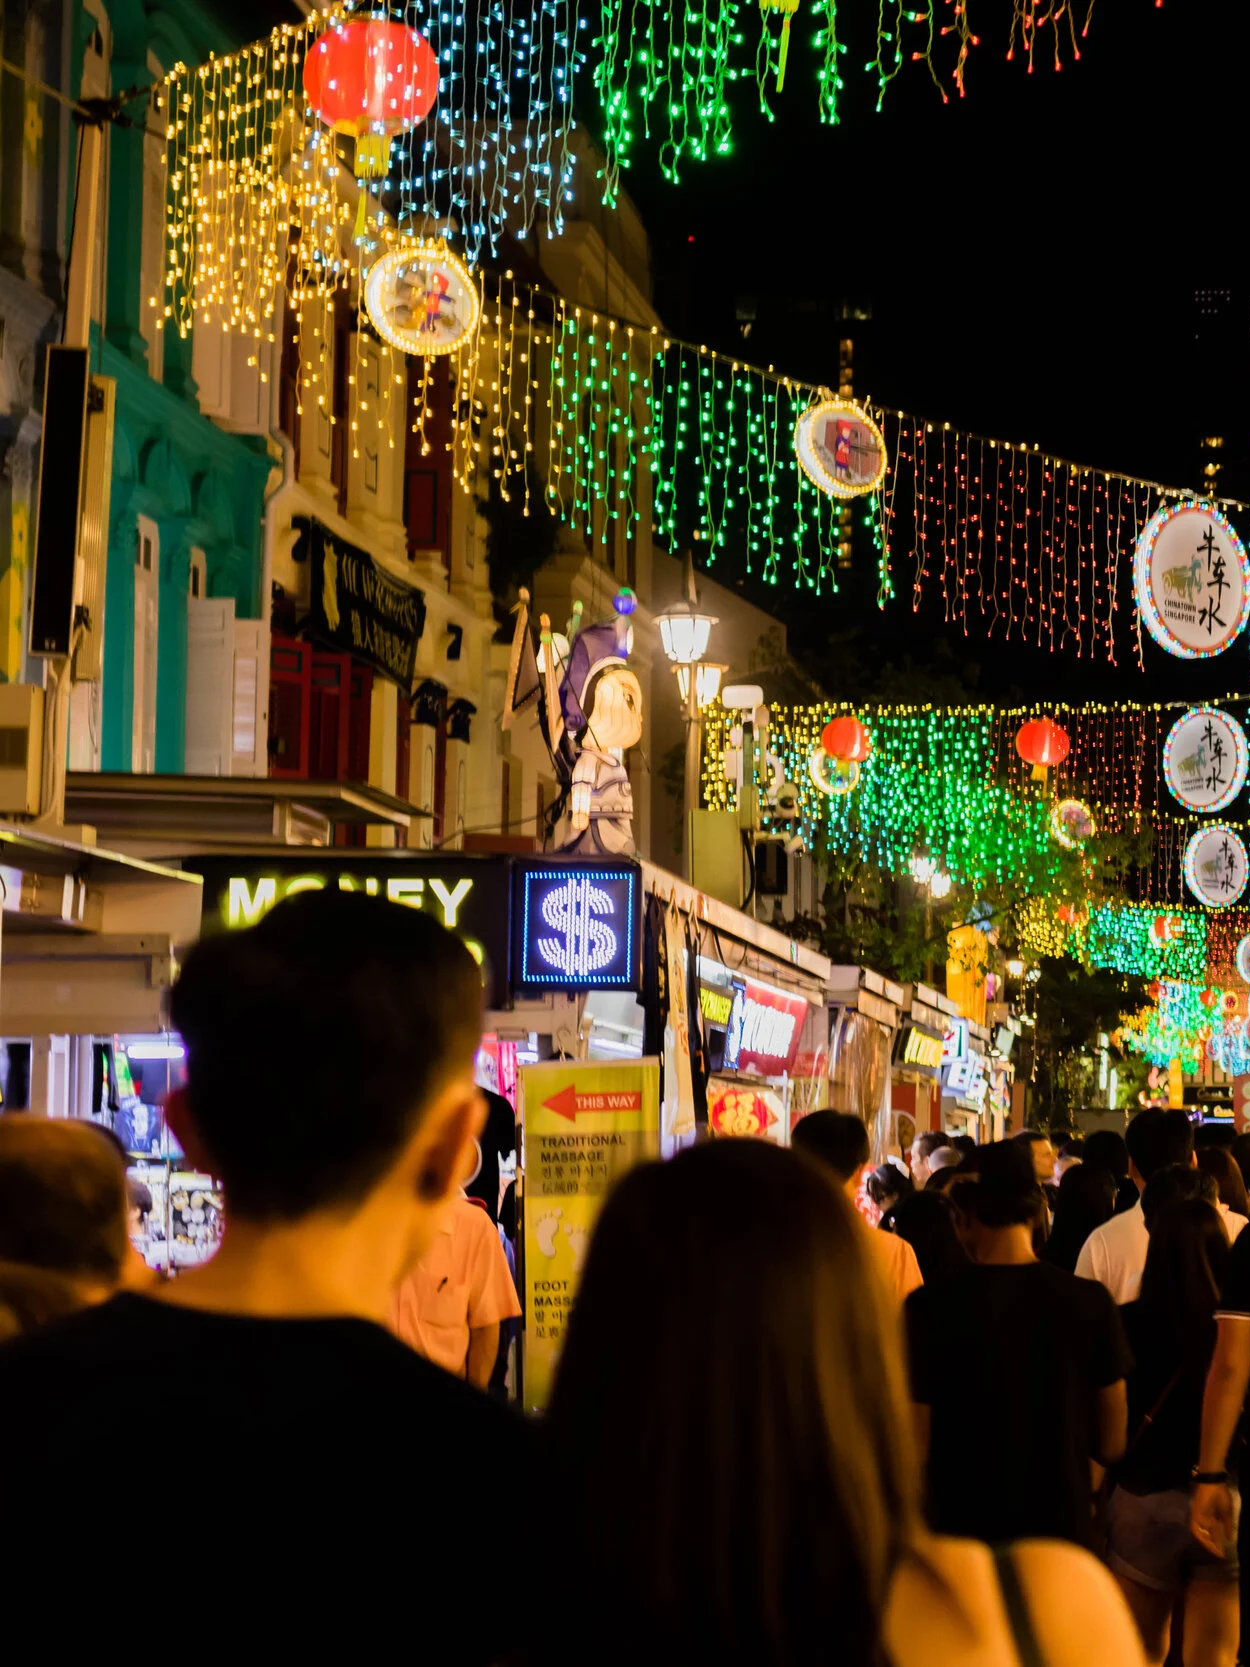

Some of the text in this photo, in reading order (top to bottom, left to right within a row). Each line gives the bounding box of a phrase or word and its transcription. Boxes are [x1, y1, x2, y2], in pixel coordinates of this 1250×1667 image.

[1164, 599, 1197, 612] CHINATOWN
[1164, 609, 1196, 624] SINGAPORE
[229, 878, 473, 927] MEY
[575, 1095, 636, 1109] THIS WAY
[541, 1135, 626, 1148] TRADITIONAL
[541, 1151, 605, 1163] MASSAGE
[534, 1280, 569, 1292] FOOT
[534, 1296, 574, 1307] MASS
